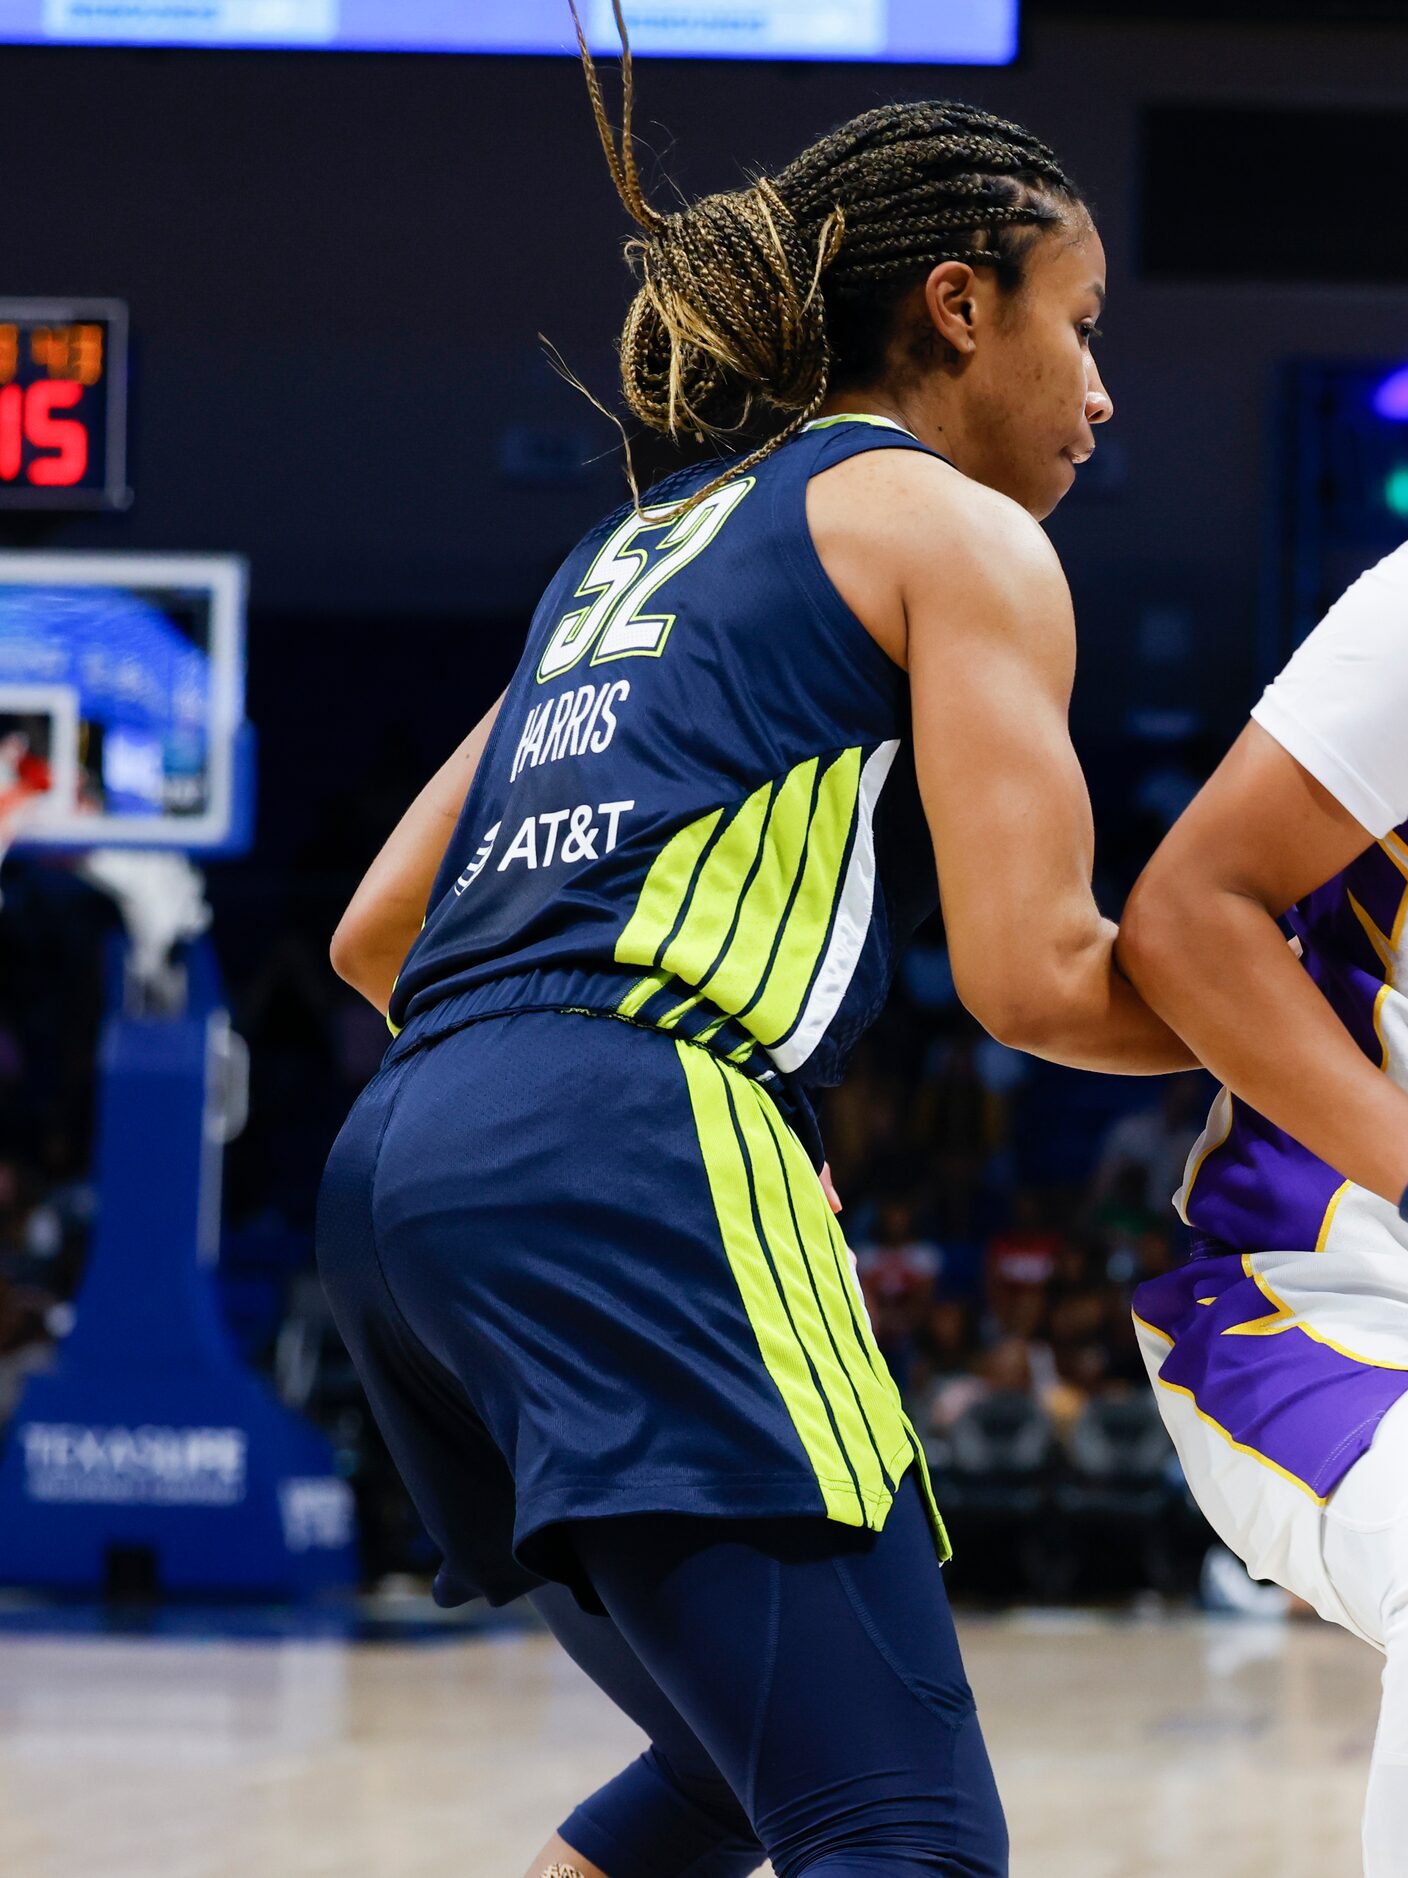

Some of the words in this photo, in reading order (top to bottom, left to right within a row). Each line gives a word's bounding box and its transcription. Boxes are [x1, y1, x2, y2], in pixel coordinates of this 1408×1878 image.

[536, 476, 756, 684] 52
[510, 680, 630, 783] HARRIS
[497, 800, 635, 871] AT&T
